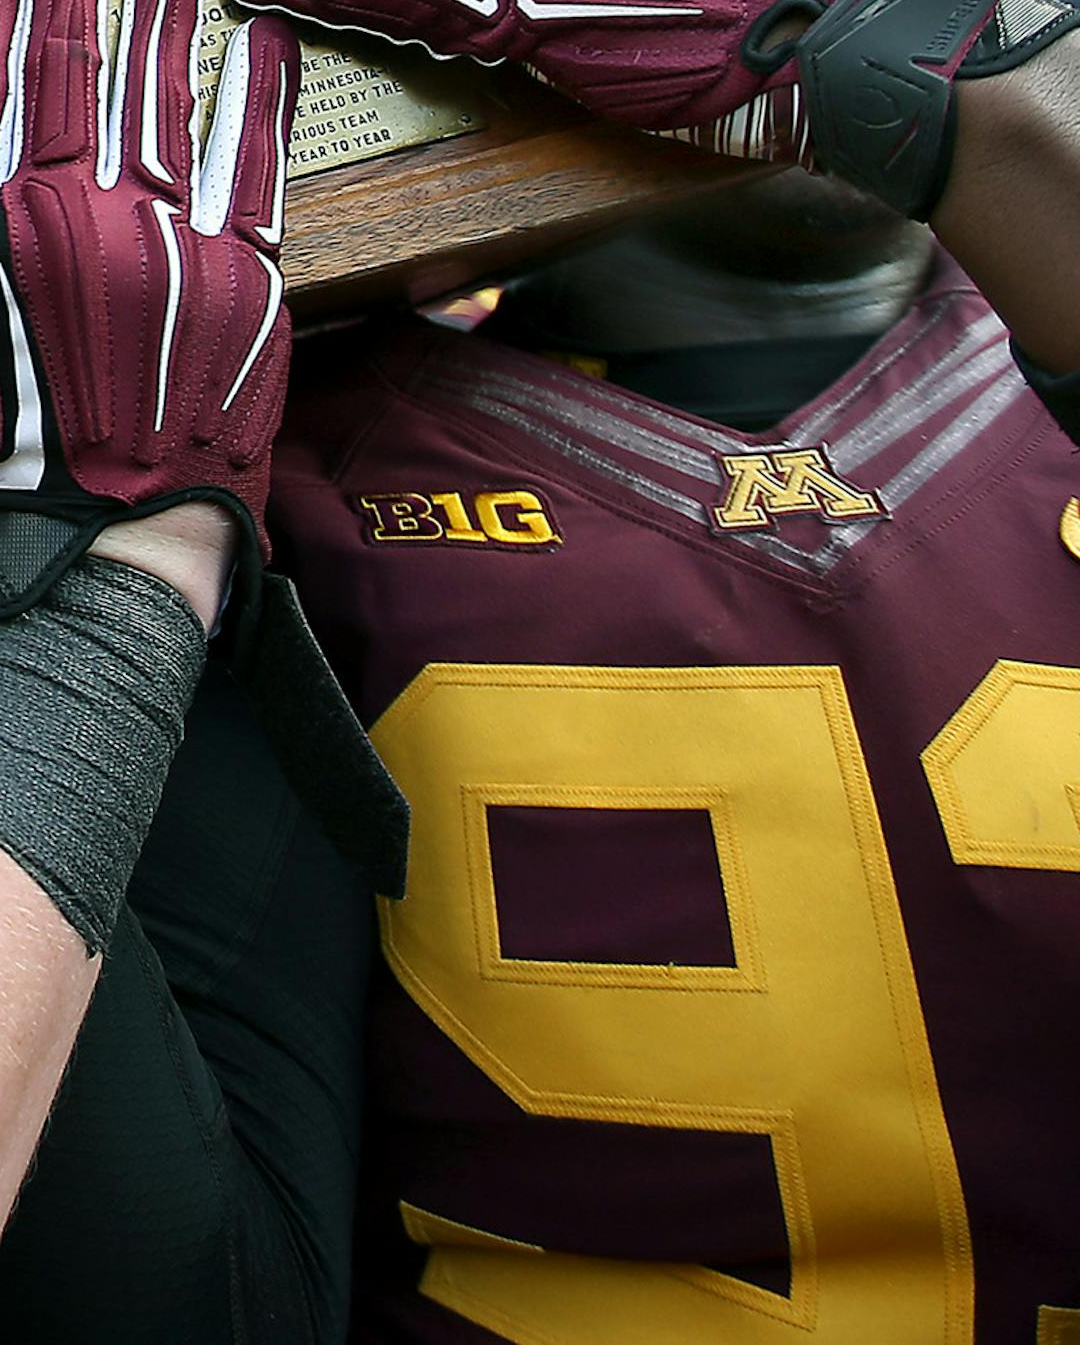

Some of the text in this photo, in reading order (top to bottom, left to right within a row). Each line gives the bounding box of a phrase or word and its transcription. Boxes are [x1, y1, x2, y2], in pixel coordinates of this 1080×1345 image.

[322, 53, 352, 67] THE
[310, 95, 346, 114] HELD
[350, 90, 367, 104] BY
[372, 81, 403, 98] THE
[292, 110, 379, 142] RIOUS TEAM
[289, 129, 391, 164] YEAR TO YEAR
